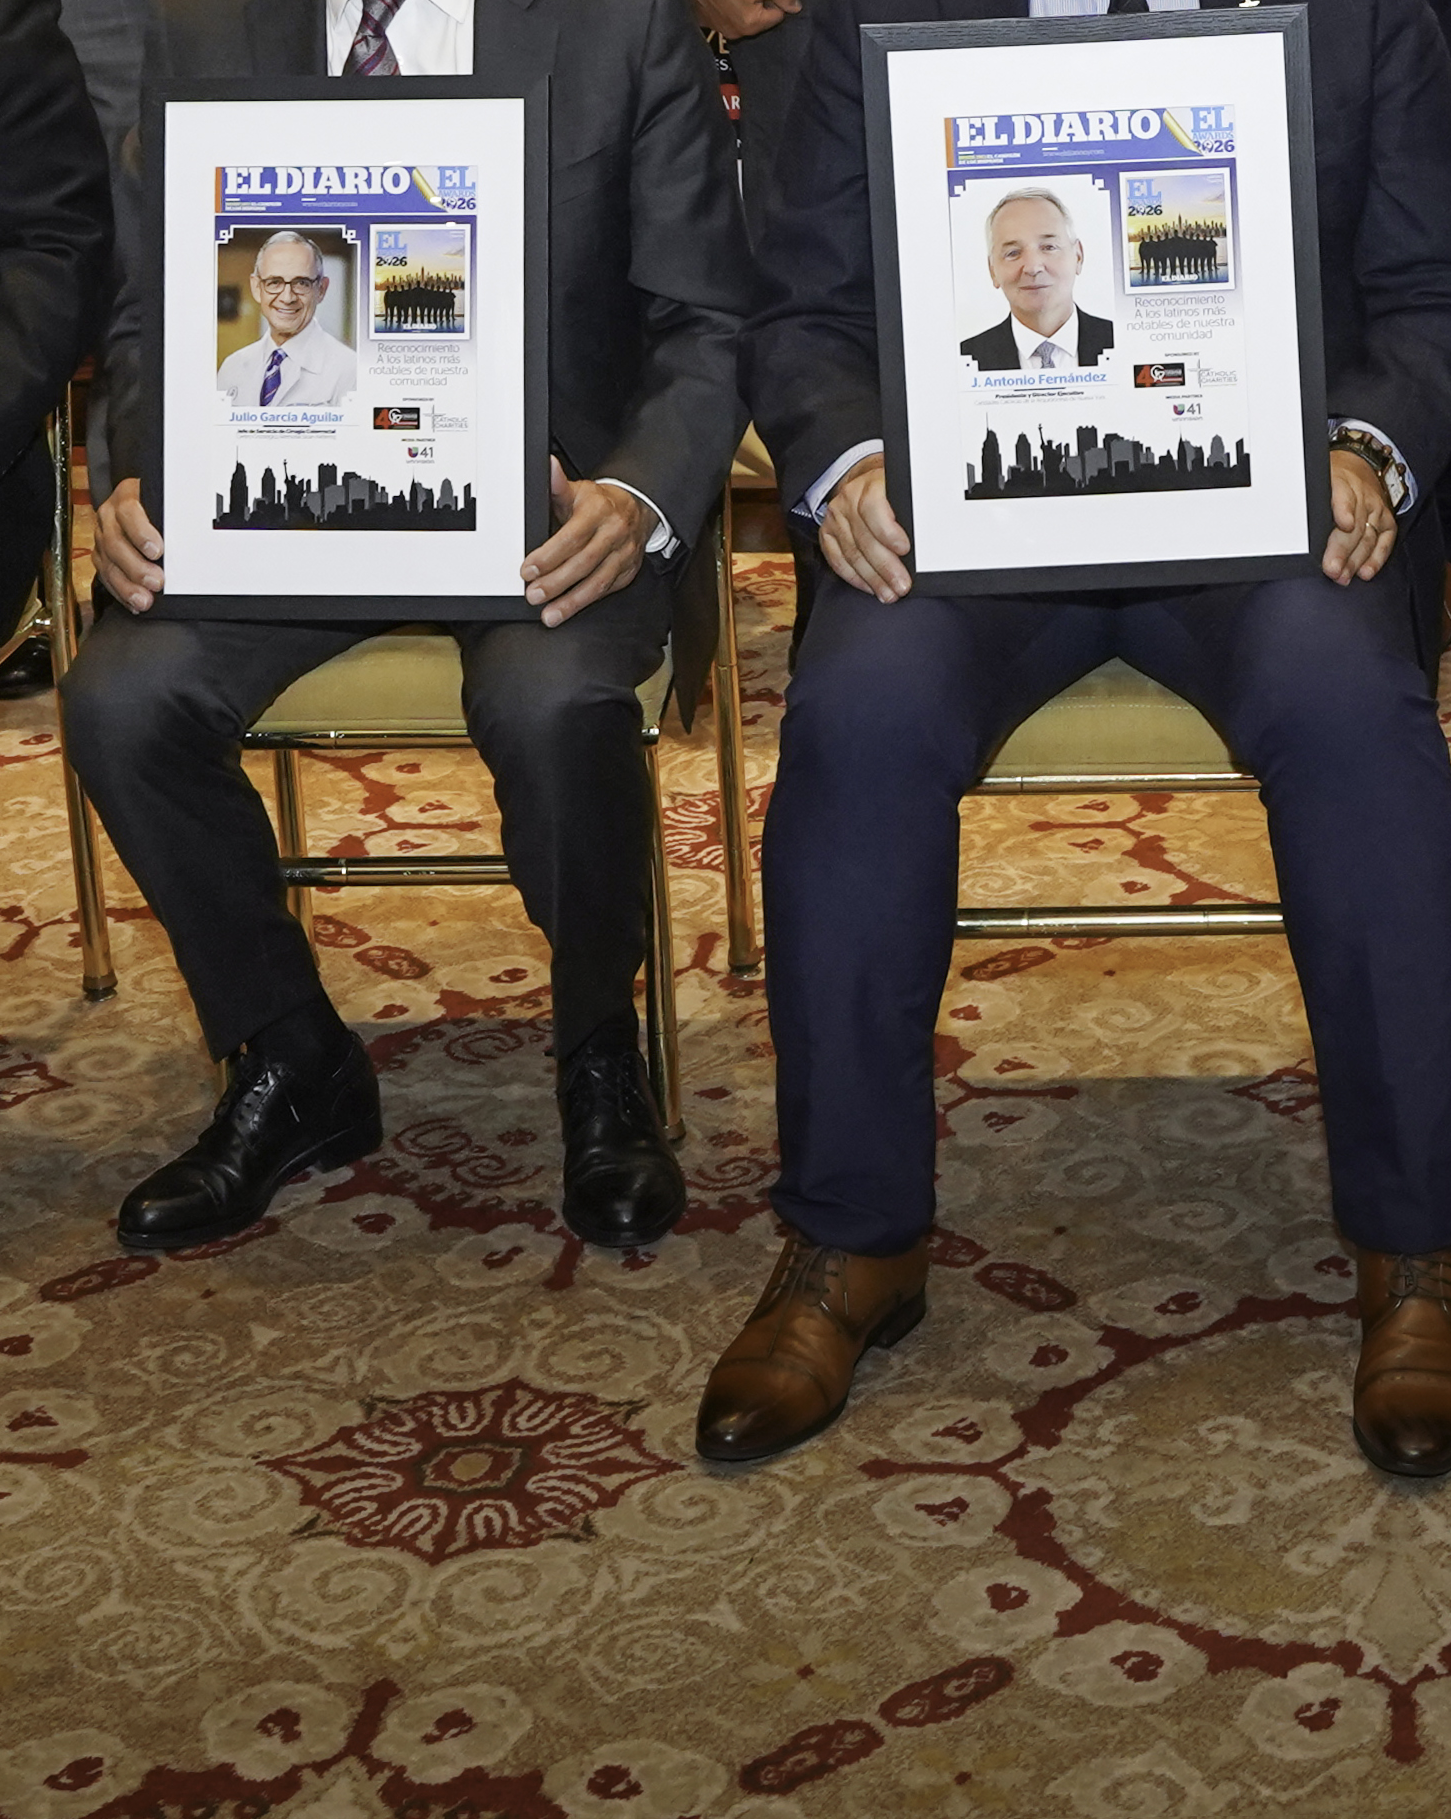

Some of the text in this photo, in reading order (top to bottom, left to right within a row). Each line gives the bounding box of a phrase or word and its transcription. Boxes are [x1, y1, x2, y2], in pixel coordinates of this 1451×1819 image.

[955, 108, 1162, 147] EL DIARIO
[1189, 105, 1232, 132] EL
[224, 167, 410, 195] EL DIARIO
[436, 167, 475, 190] EL
[971, 371, 1106, 388] J. Antonio Fernández
[229, 412, 343, 424] Julio García Aguilar
[1186, 403, 1202, 415] 41
[421, 447, 433, 458] 41
